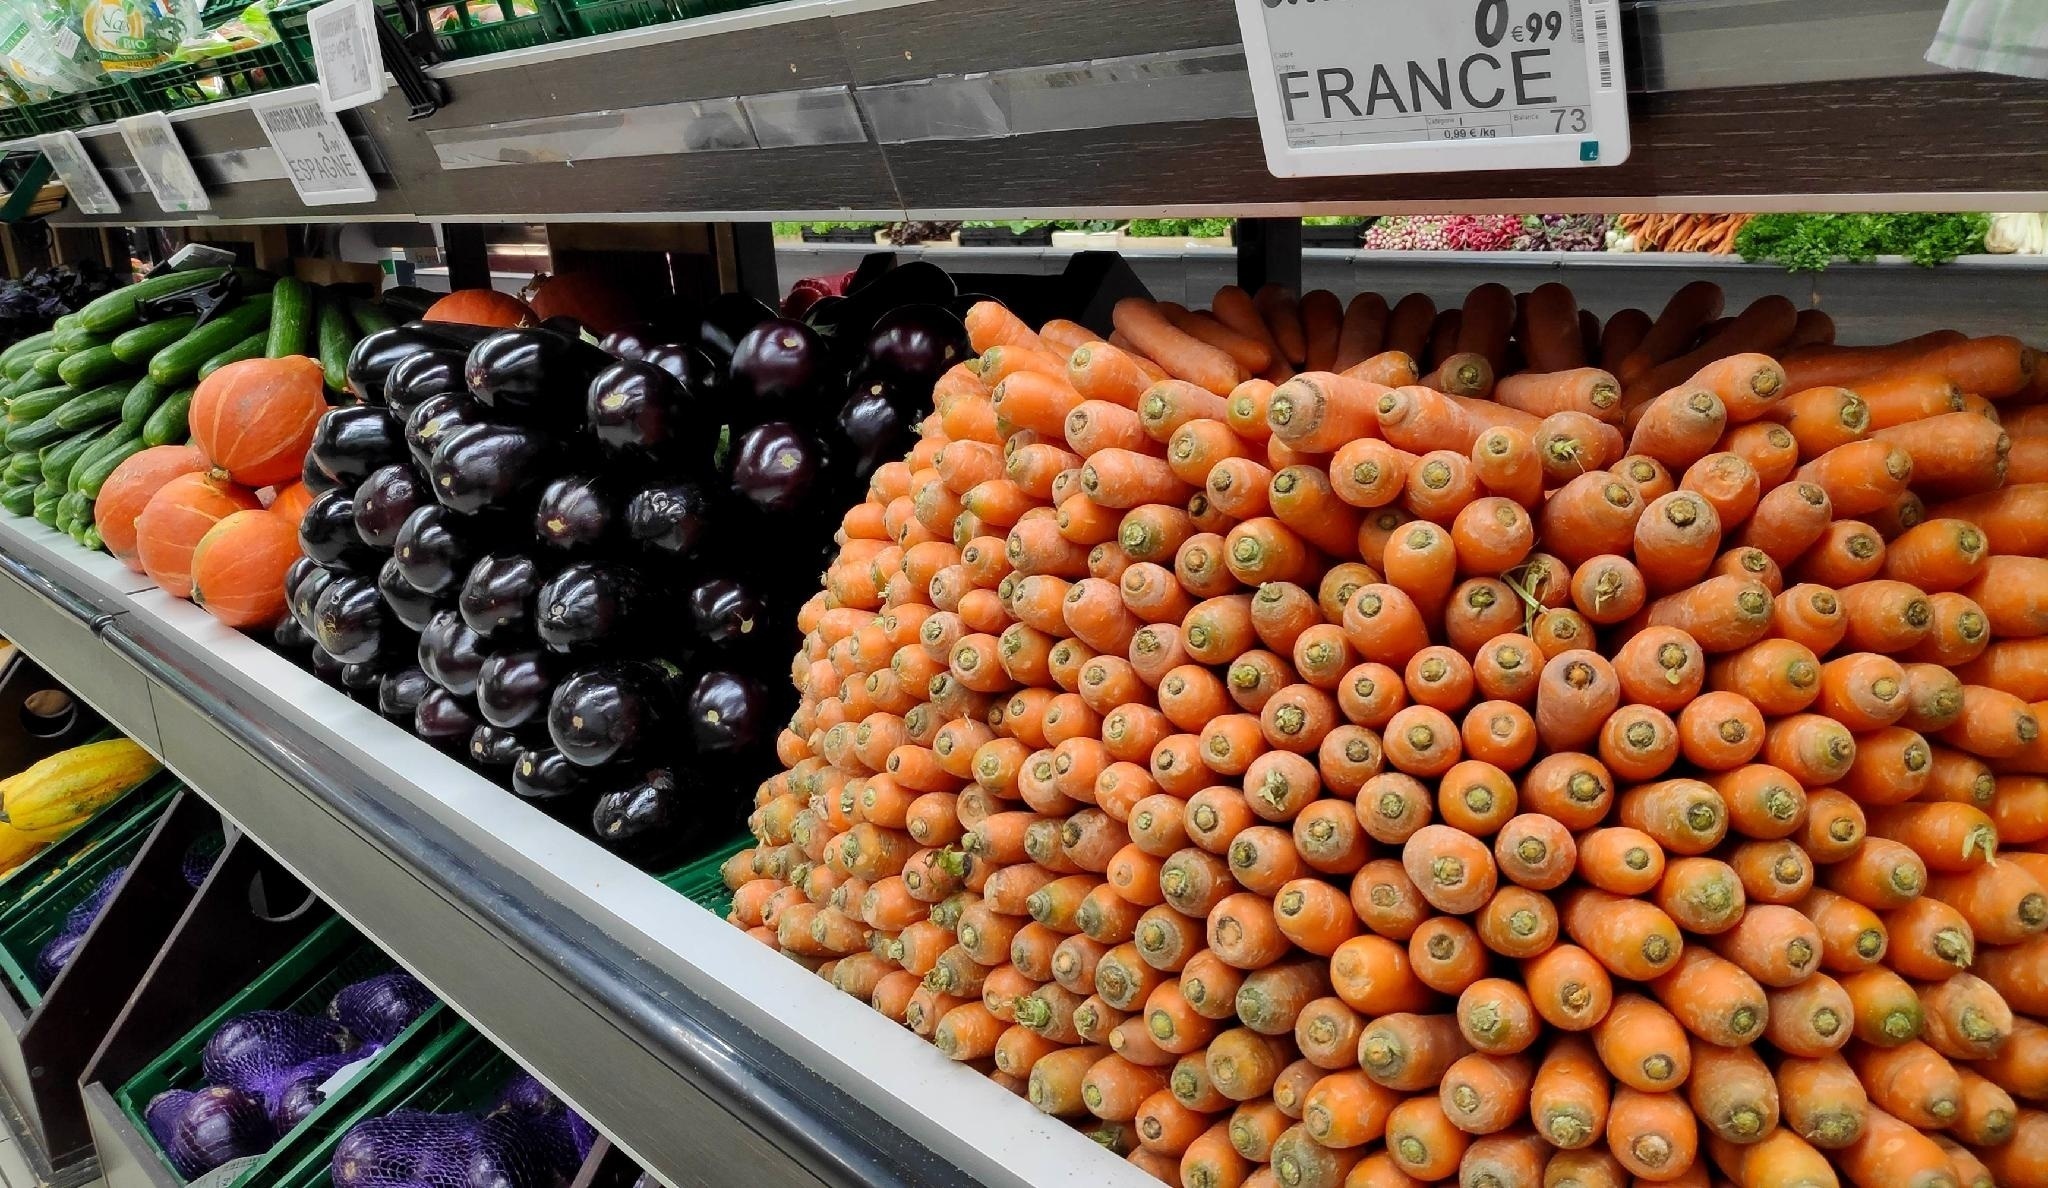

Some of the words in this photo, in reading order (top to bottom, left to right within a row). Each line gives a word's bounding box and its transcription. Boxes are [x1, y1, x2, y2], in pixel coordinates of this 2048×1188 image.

[123, 39, 148, 50] BIO
[1279, 48, 1557, 121] FRANCE
[1443, 128, 1467, 140] 0,99
[1469, 129, 1477, 138] €
[1480, 128, 1496, 139] /kg
[1549, 108, 1587, 134] 73
[288, 153, 357, 182] ESPAGNE
